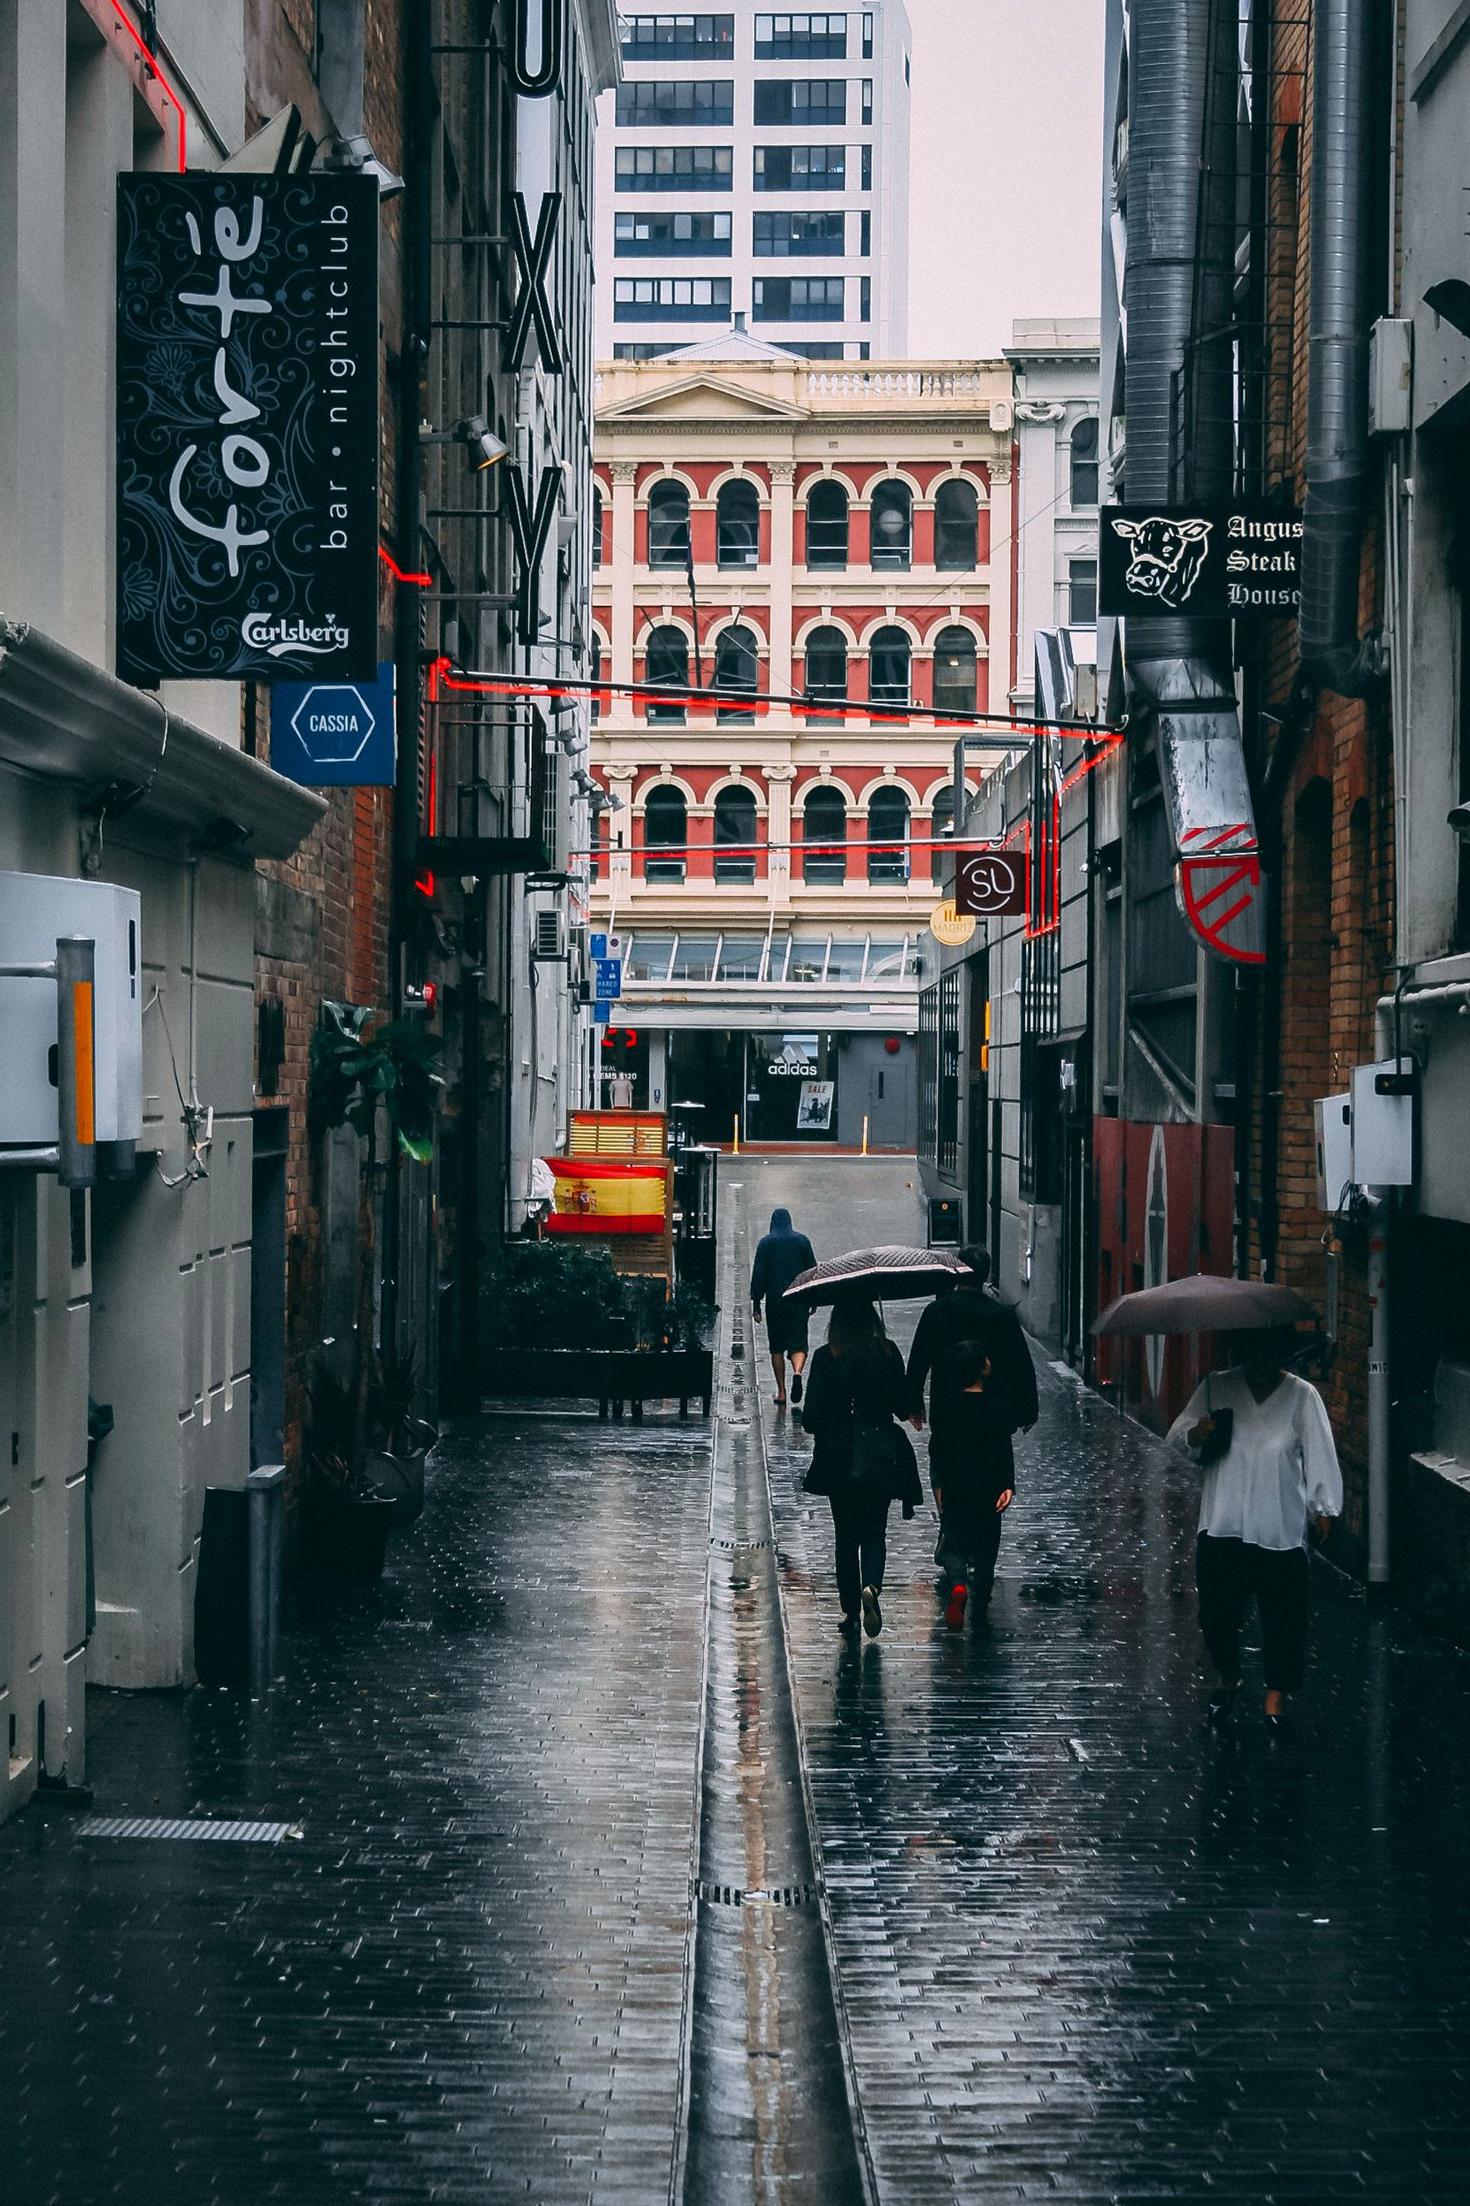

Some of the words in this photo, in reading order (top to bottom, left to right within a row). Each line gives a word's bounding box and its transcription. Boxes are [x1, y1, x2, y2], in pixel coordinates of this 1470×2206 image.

[320, 204, 357, 424] nightclub
[320, 485, 348, 550] bar
[1227, 515, 1303, 542] Angus
[1227, 550, 1296, 573] Steak
[1227, 583, 1303, 608] House
[240, 611, 349, 657] Carlsberg
[309, 713, 359, 734] CASSIA
[768, 1063, 817, 1076] adidas
[807, 1085, 827, 1094] SALE
